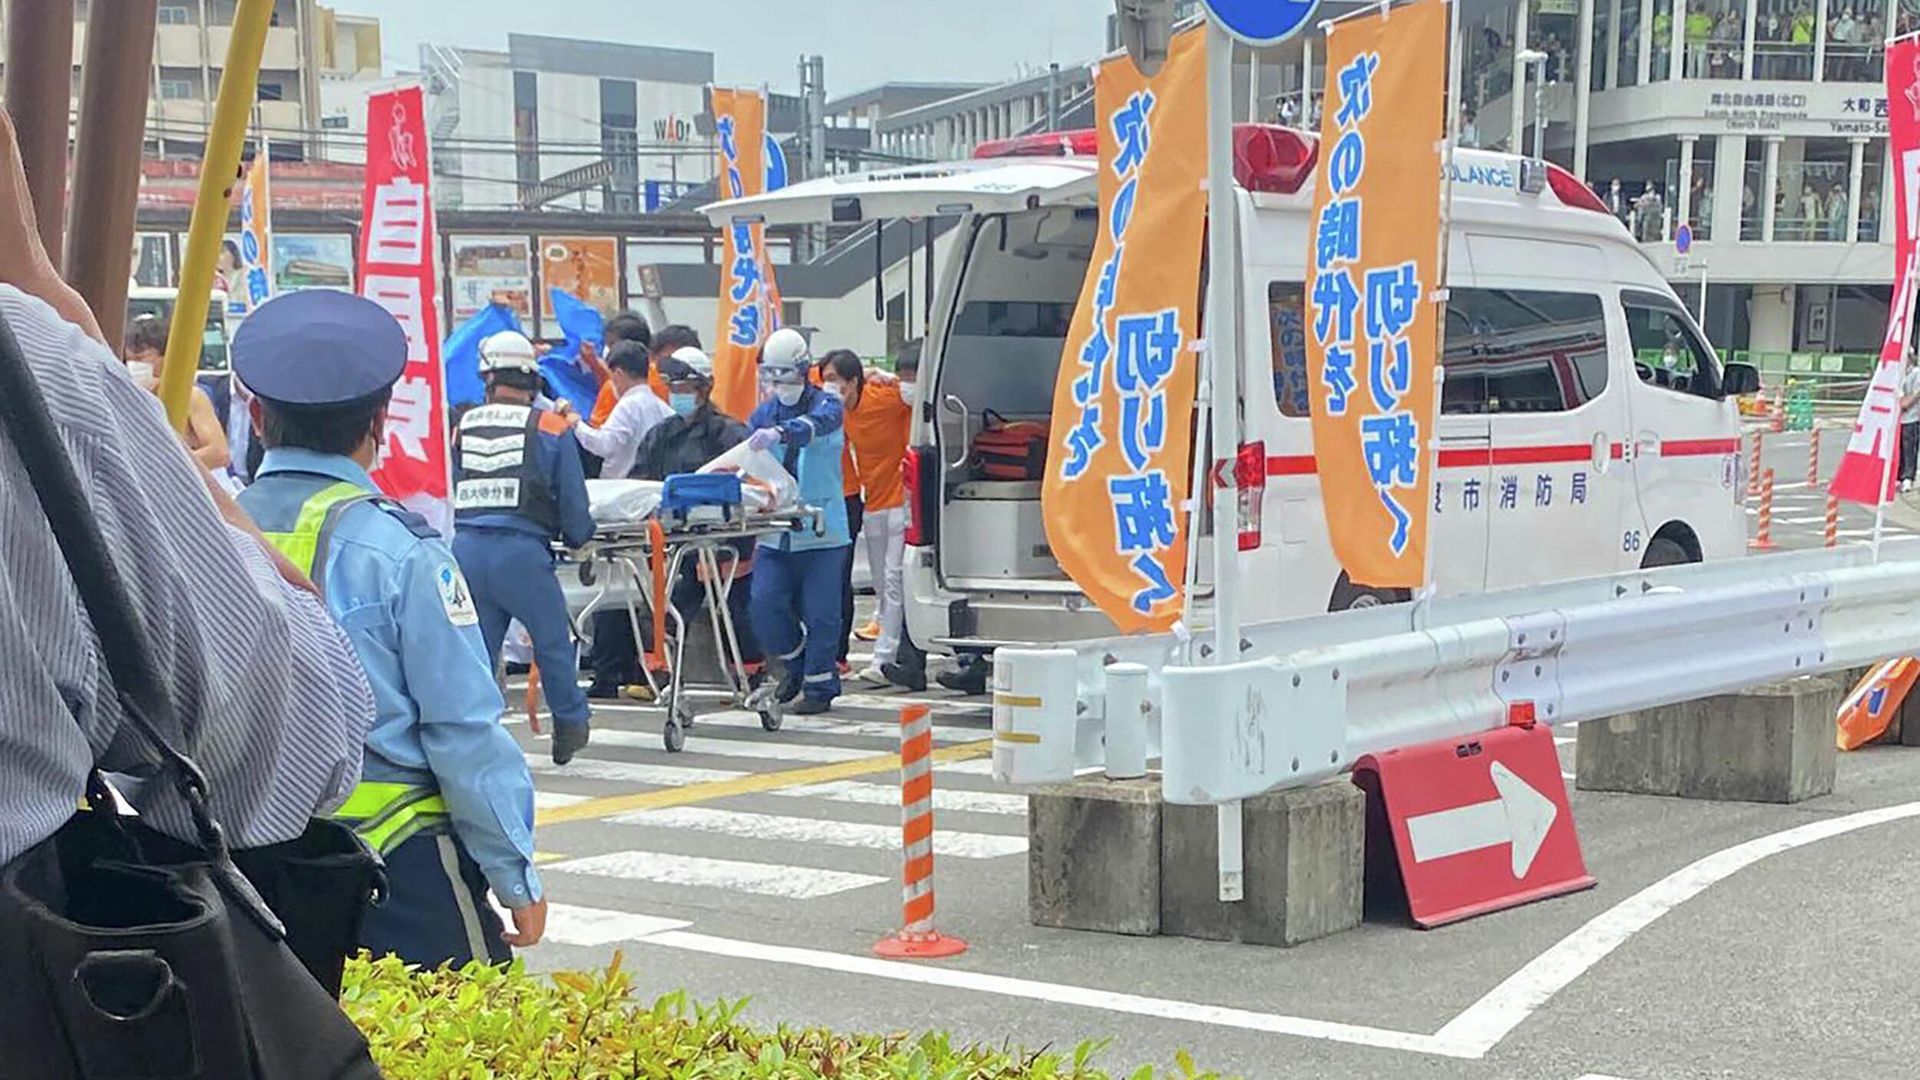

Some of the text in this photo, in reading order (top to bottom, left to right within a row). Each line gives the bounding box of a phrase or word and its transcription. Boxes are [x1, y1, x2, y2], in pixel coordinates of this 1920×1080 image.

[654, 112, 690, 142] WAO!
[1434, 471, 1587, 513] 市消防局
[1623, 531, 1640, 551] 86
